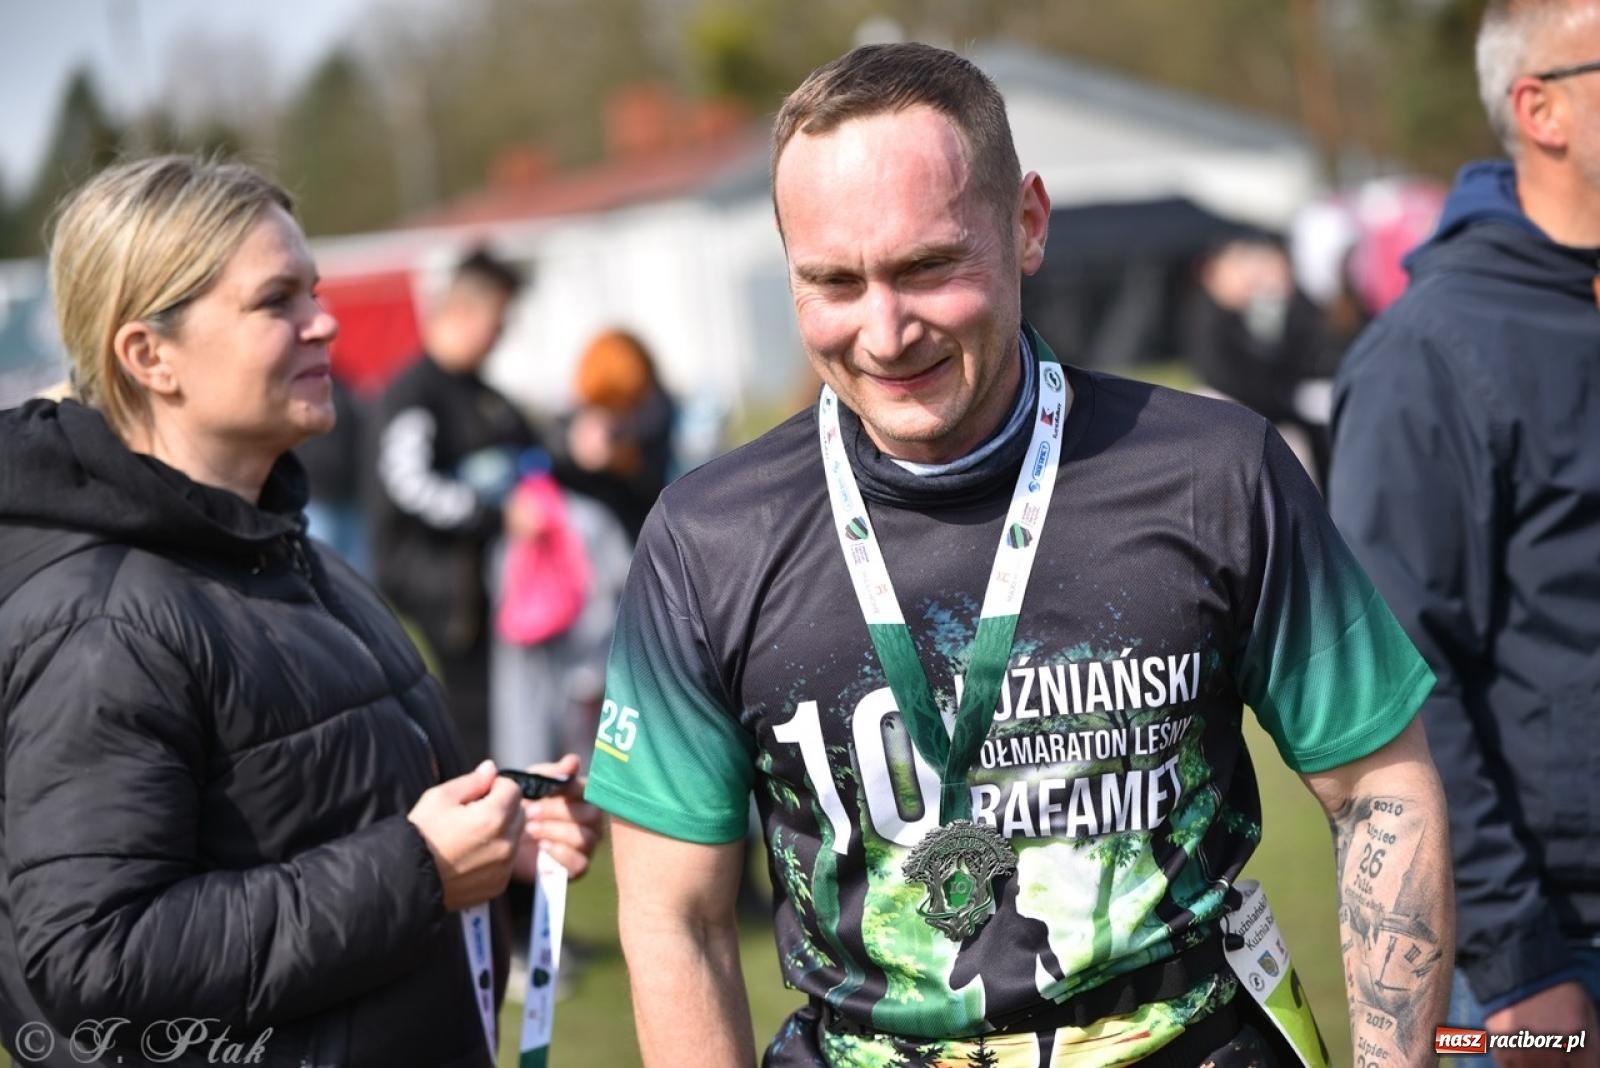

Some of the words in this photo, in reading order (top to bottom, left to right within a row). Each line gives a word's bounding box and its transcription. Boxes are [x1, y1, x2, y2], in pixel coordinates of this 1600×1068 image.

[1135, 714, 1191, 755] LEŚNY
[772, 687, 942, 855] 10
[970, 754, 1182, 838] RAFAMET
[1374, 800, 1403, 816] 2010
[1360, 842, 1385, 878] 26
[1366, 1012, 1392, 1030] 2017
